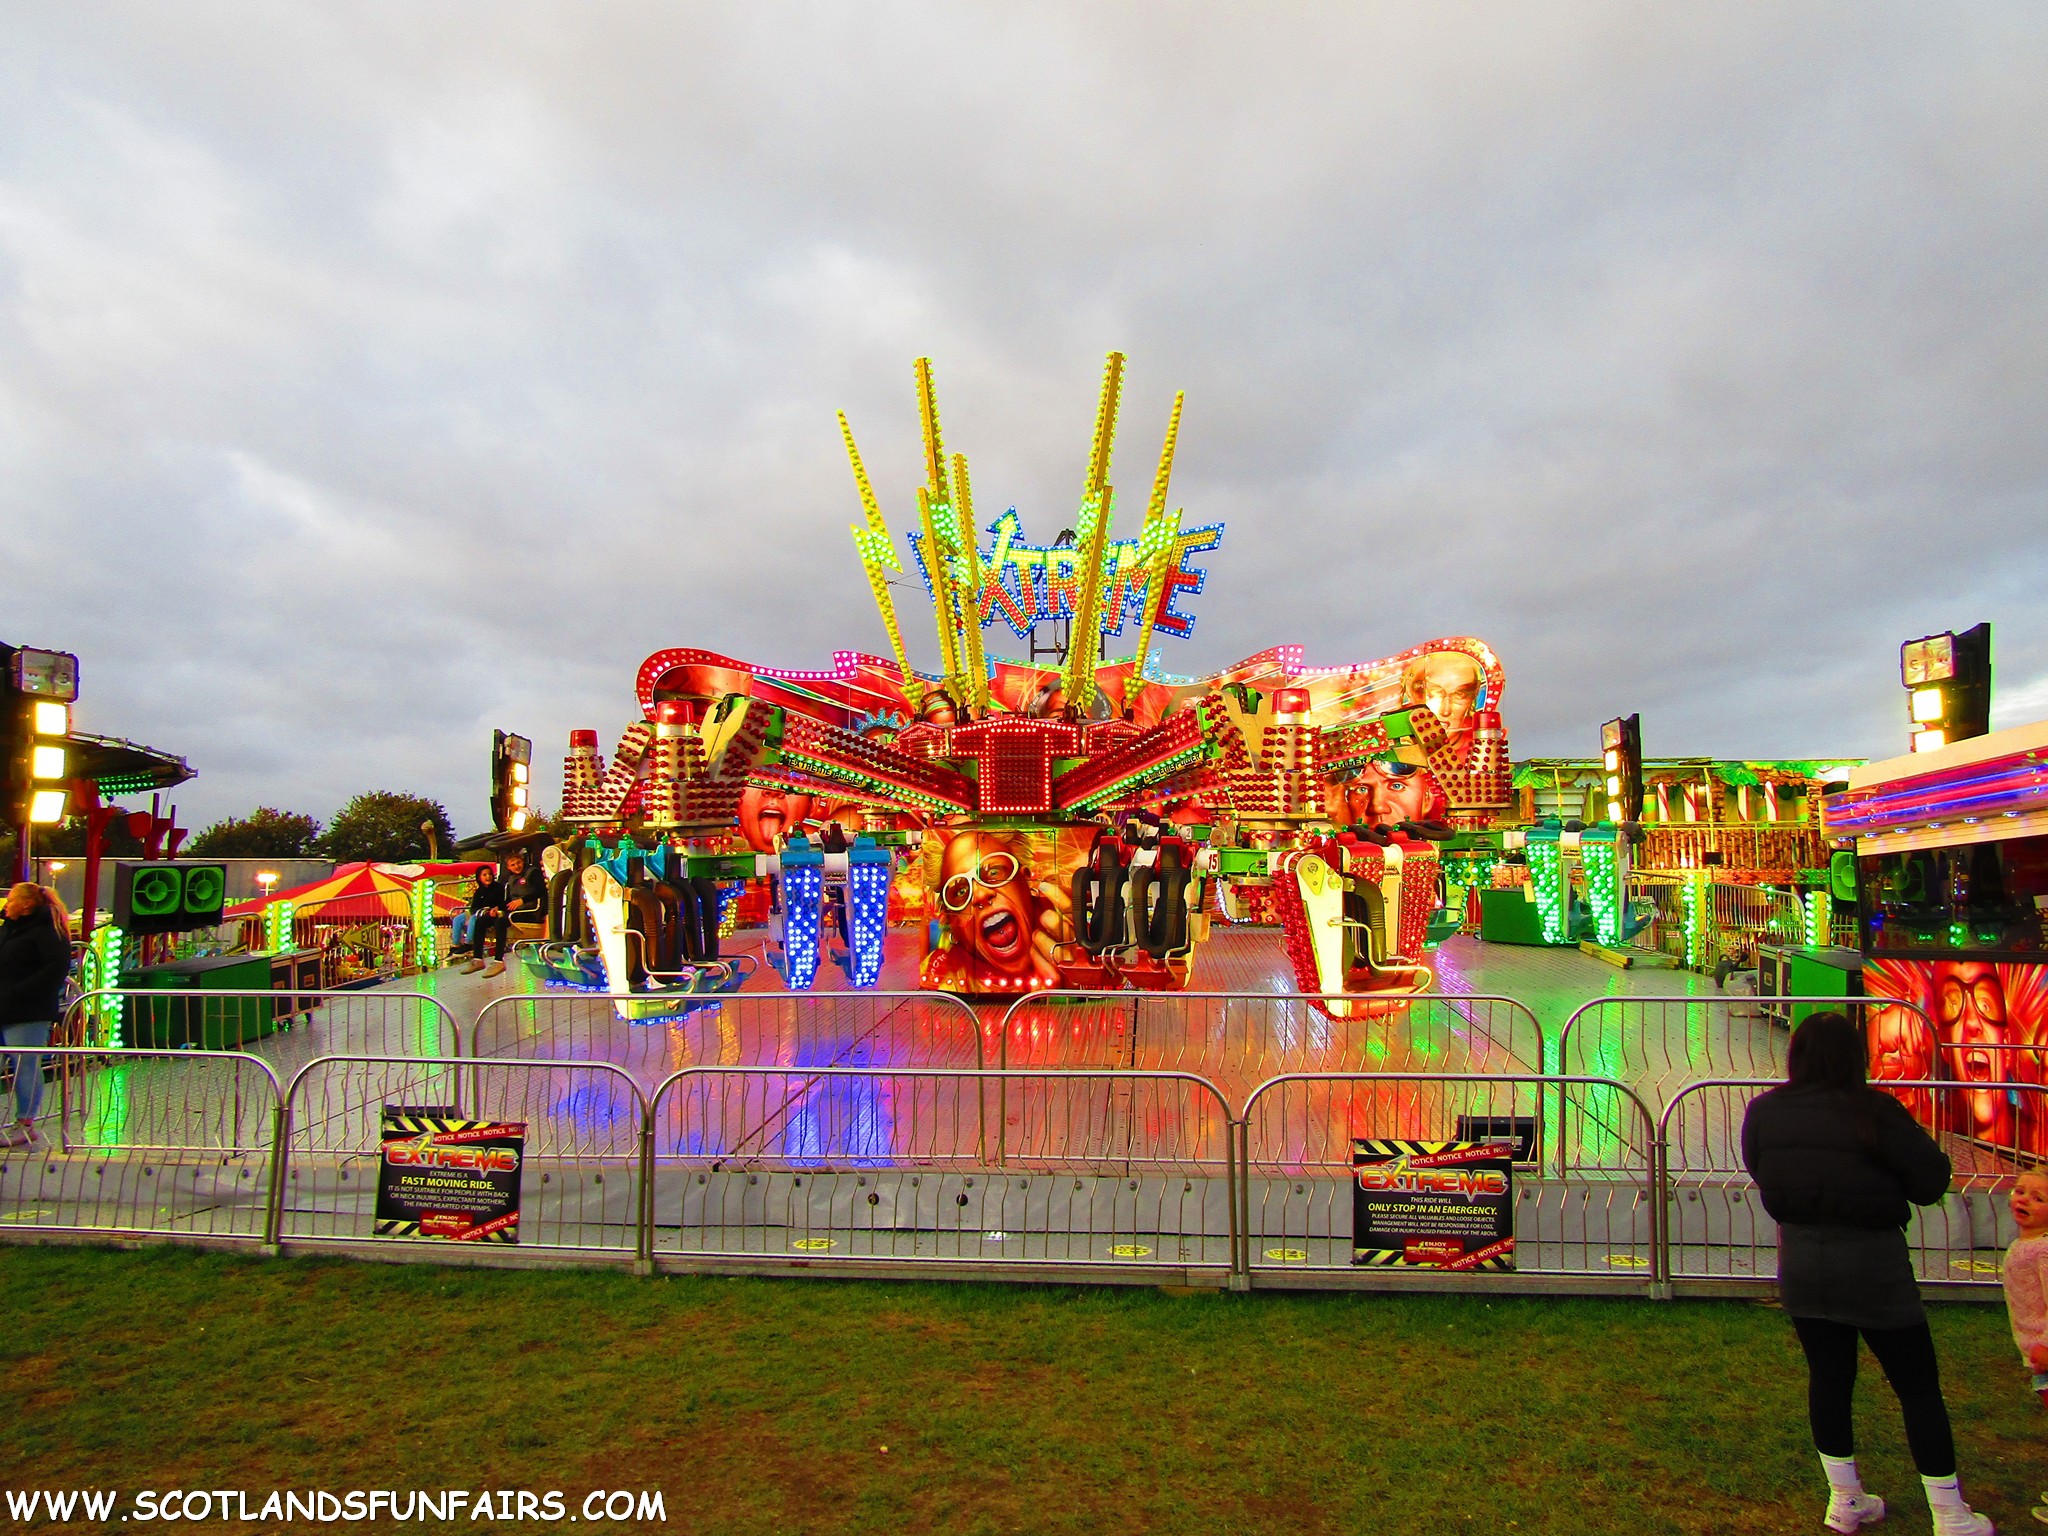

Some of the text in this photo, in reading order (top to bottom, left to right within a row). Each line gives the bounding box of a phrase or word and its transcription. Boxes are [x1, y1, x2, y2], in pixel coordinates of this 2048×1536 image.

[1208, 854, 1218, 870] 15
[361, 927, 378, 948] EXIT
[457, 1131, 480, 1139] NOTICE
[483, 1128, 506, 1136] NOTICE
[387, 1134, 518, 1175] EXTREME
[1411, 1156, 1434, 1165] NOTICE
[1437, 1152, 1462, 1161] NOTICE
[1465, 1148, 1490, 1158] NOTICE
[401, 1176, 495, 1190] FAST MOVING RIDE.
[1360, 1156, 1508, 1200] EXTREME
[1368, 1203, 1498, 1215] ONLY STOP IN AN EMERGENCY.
[461, 1227, 484, 1240] NOTICE
[485, 1218, 508, 1231] NOTICE
[1451, 1254, 1476, 1269] NOTICE
[1477, 1245, 1502, 1258] NOTICE
